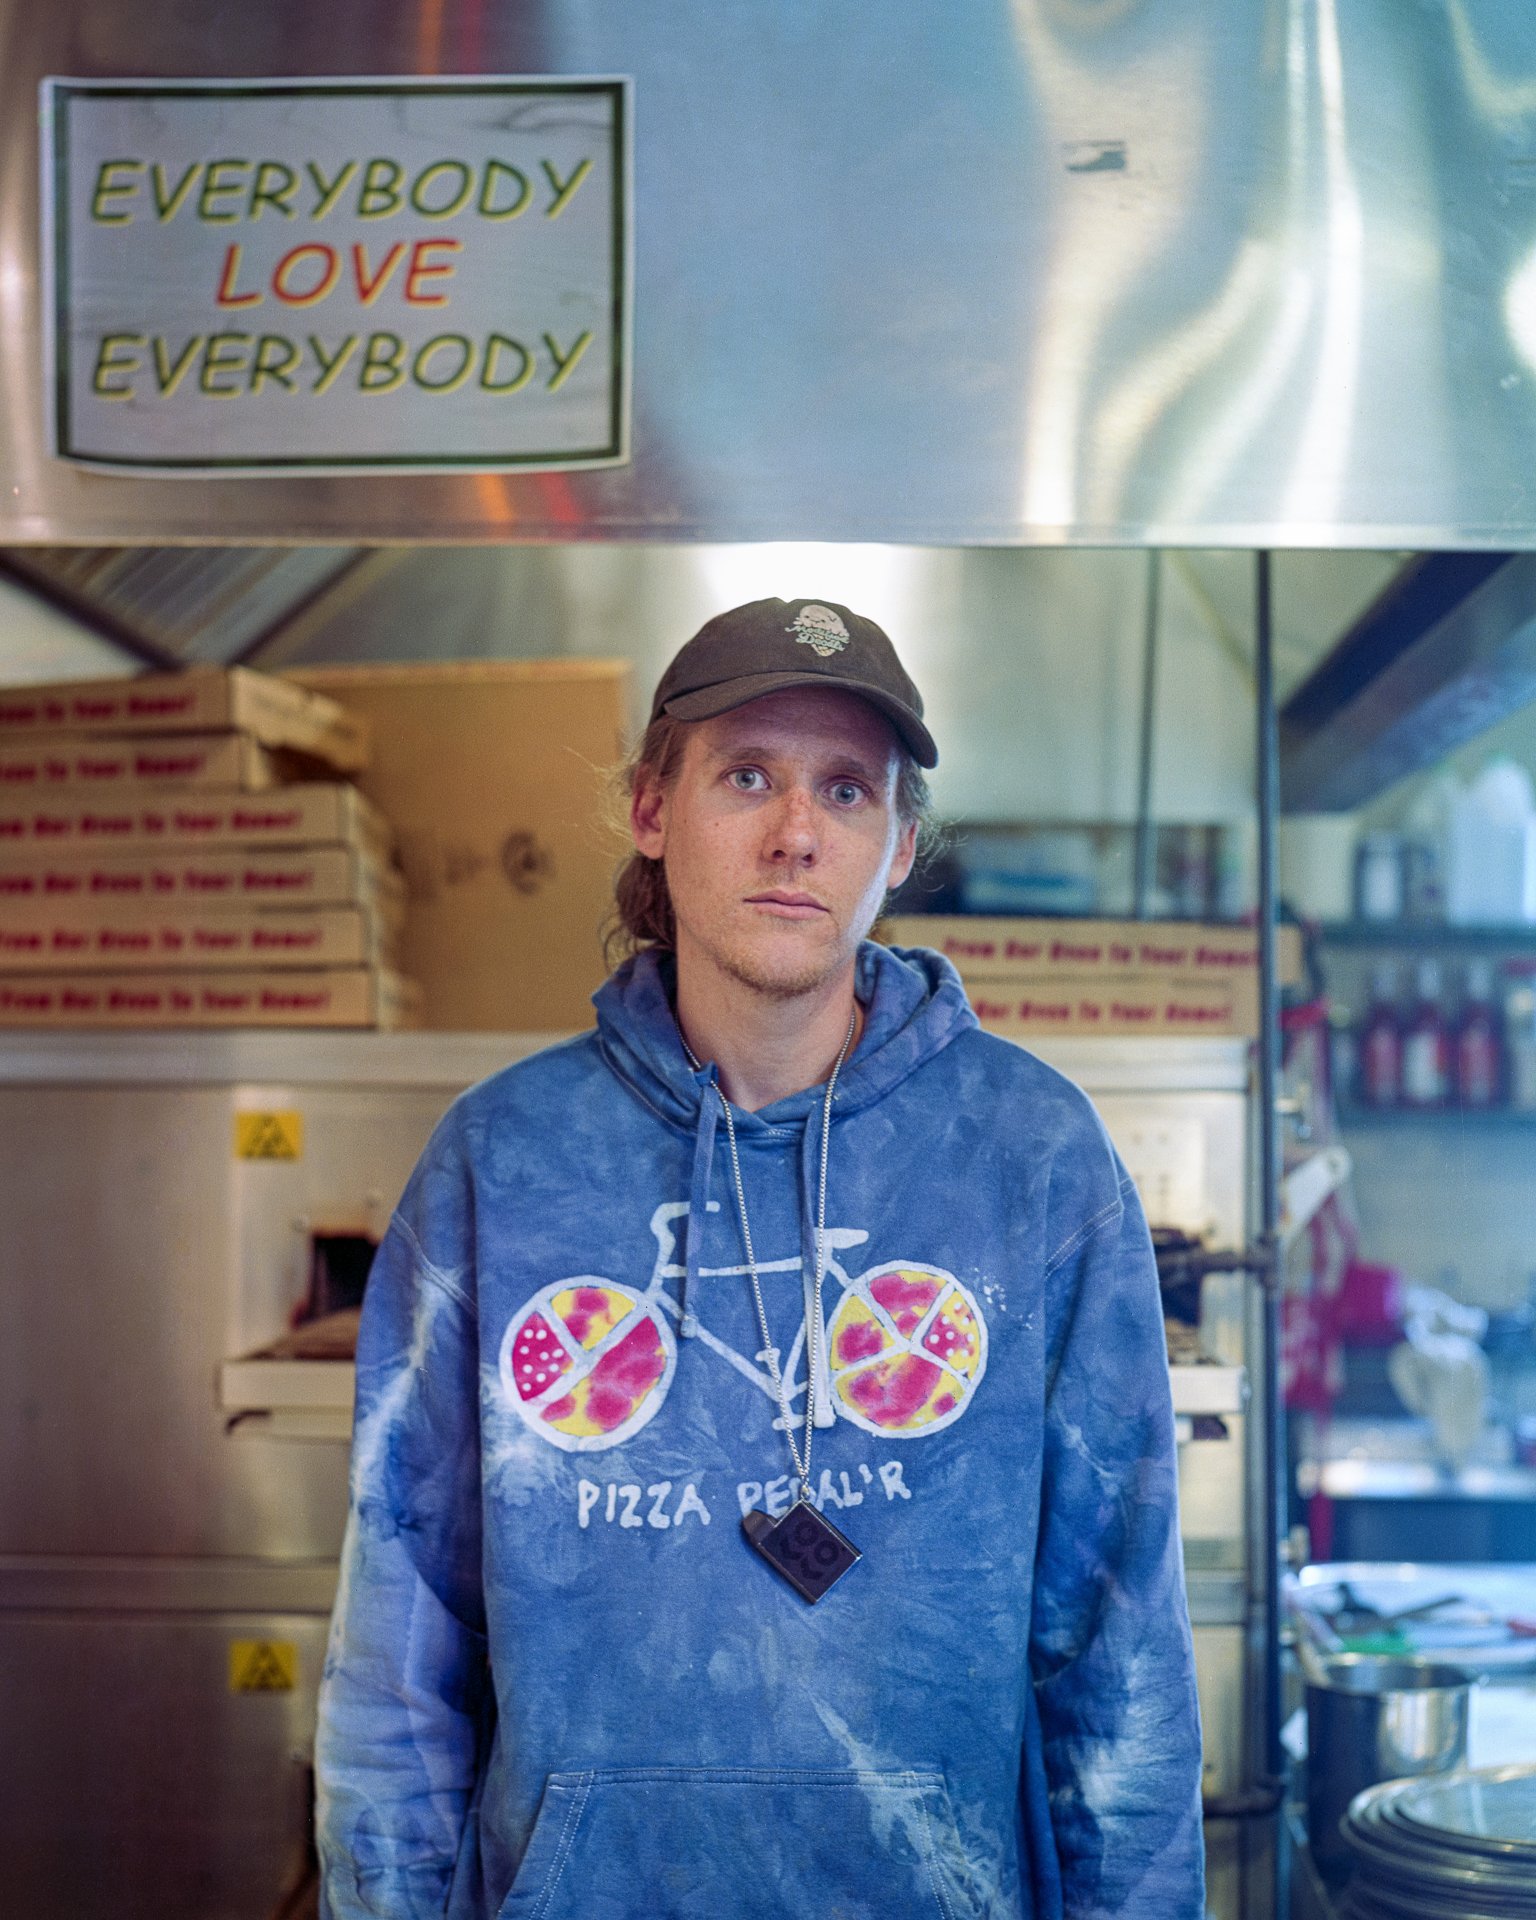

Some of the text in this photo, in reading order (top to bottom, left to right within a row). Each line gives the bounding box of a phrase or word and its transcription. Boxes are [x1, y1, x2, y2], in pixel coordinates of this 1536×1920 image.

[90, 158, 593, 226] EVERYBODY
[216, 239, 463, 309] LOVE
[92, 330, 594, 399] EVERYBODY
[578, 1479, 711, 1529] PIZZA
